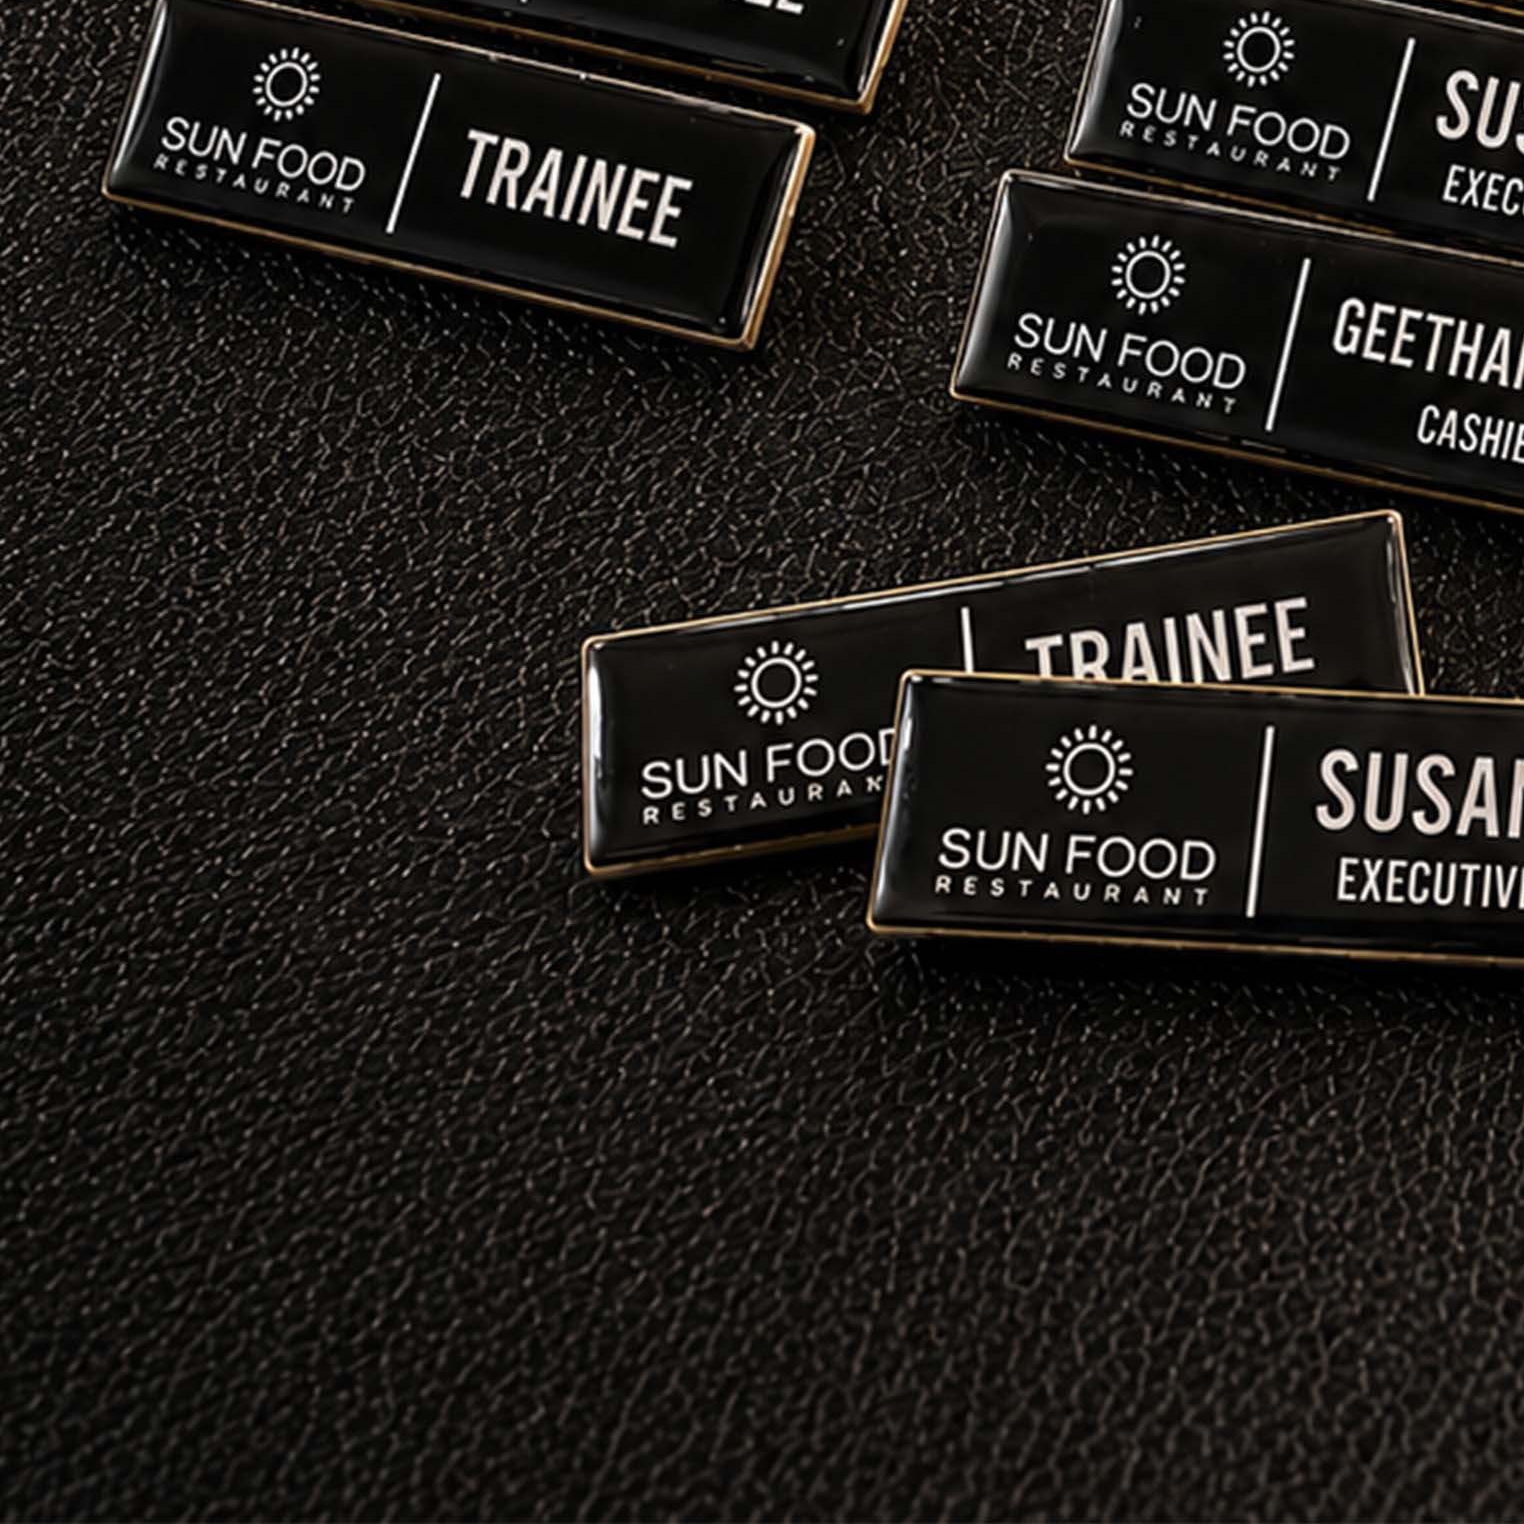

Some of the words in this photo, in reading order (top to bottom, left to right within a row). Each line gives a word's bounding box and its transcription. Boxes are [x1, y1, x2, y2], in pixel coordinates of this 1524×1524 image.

[1120, 120, 1340, 182] RESTAURANT
[1125, 83, 1218, 131] SUN
[1227, 105, 1350, 161] FOOD
[153, 155, 357, 213] RESTAURANT
[161, 116, 246, 164] SUN
[252, 136, 365, 192] FOOD
[460, 129, 692, 248] TRAINEE
[1014, 313, 1109, 362] SUN
[1117, 334, 1246, 390] FOOD
[1008, 356, 1238, 414] RESTAURANT
[1025, 597, 1315, 684] TRAINEE
[641, 749, 748, 799] SUN
[938, 827, 1049, 874] SUN
[1065, 835, 1216, 880] FOOD
[934, 876, 1210, 906] RESTAURANT
